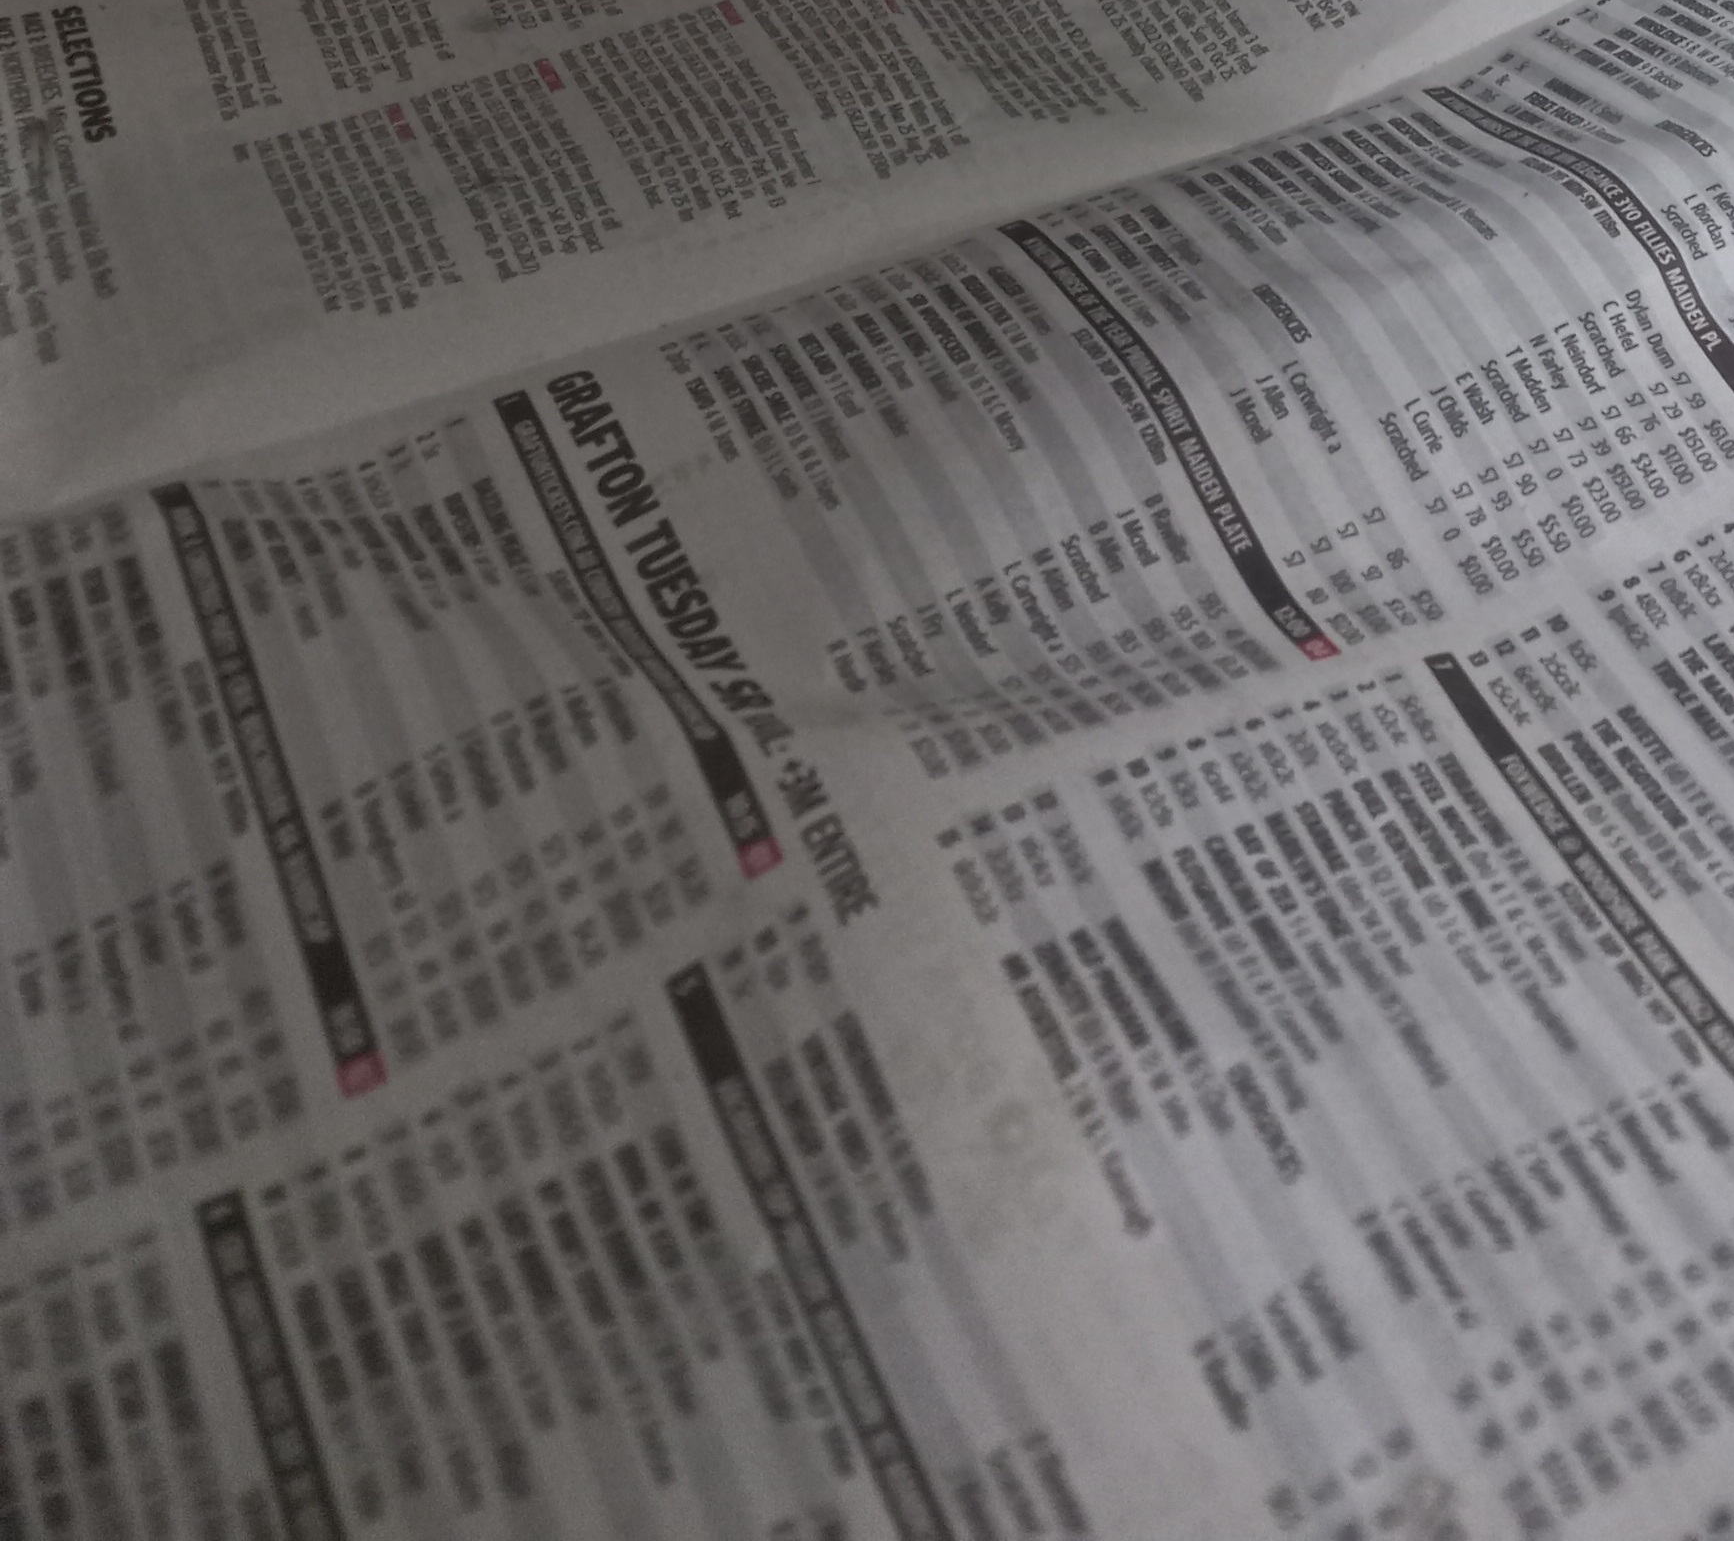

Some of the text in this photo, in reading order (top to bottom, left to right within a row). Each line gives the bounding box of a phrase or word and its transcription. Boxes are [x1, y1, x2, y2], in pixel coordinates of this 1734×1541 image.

[52, 5, 117, 144] SELECTIONS
[1613, 192, 1643, 224] 3YO
[1633, 219, 1678, 266] FILLIES
[1664, 266, 1711, 332] MAIDEN
[1699, 329, 1723, 353] PL
[1691, 200, 1727, 251] Riordan
[1578, 311, 1626, 379] Scratched
[1608, 310, 1639, 354] Hefel
[1624, 288, 1654, 335] Dylan
[1646, 331, 1677, 370] Dunn
[1411, 409, 1444, 456] Currie
[1512, 357, 1622, 525] Madden $23.00
[1560, 331, 1670, 500] Neindorf $34.00
[1178, 434, 1224, 507] MAIDEN
[1209, 501, 1253, 556] PLATE
[546, 368, 661, 530] GRAFTON
[624, 516, 748, 675] TUESDAY
[800, 812, 881, 927] ENTIRE
